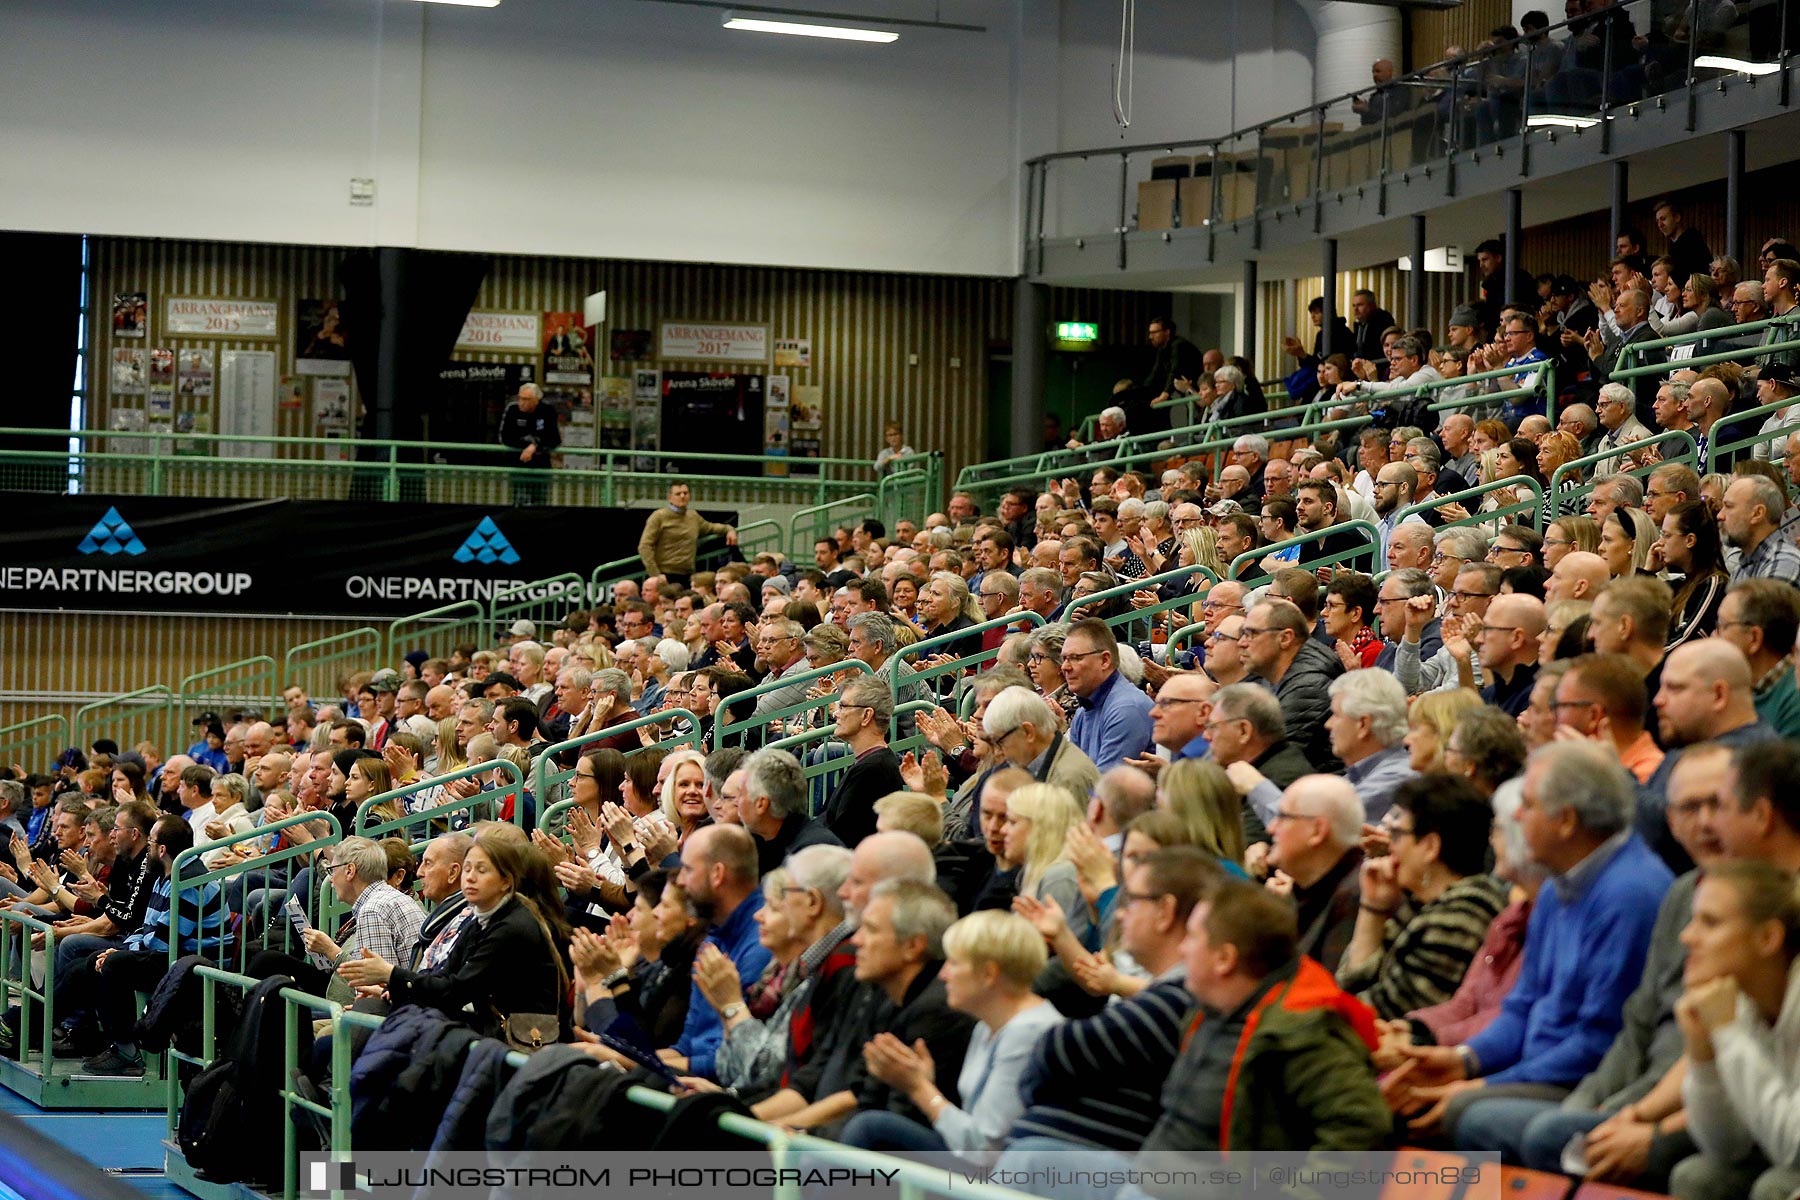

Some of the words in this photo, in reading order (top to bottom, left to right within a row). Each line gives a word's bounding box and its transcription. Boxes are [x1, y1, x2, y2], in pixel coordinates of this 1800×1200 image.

[1446, 245, 1457, 266] E
[173, 301, 275, 317] ARRANGEMANG
[205, 316, 240, 331] 2015
[467, 328, 503, 344] 2016
[666, 325, 764, 342] ARRANGEMANG
[697, 340, 731, 355] 2017
[668, 379, 697, 389] Arena
